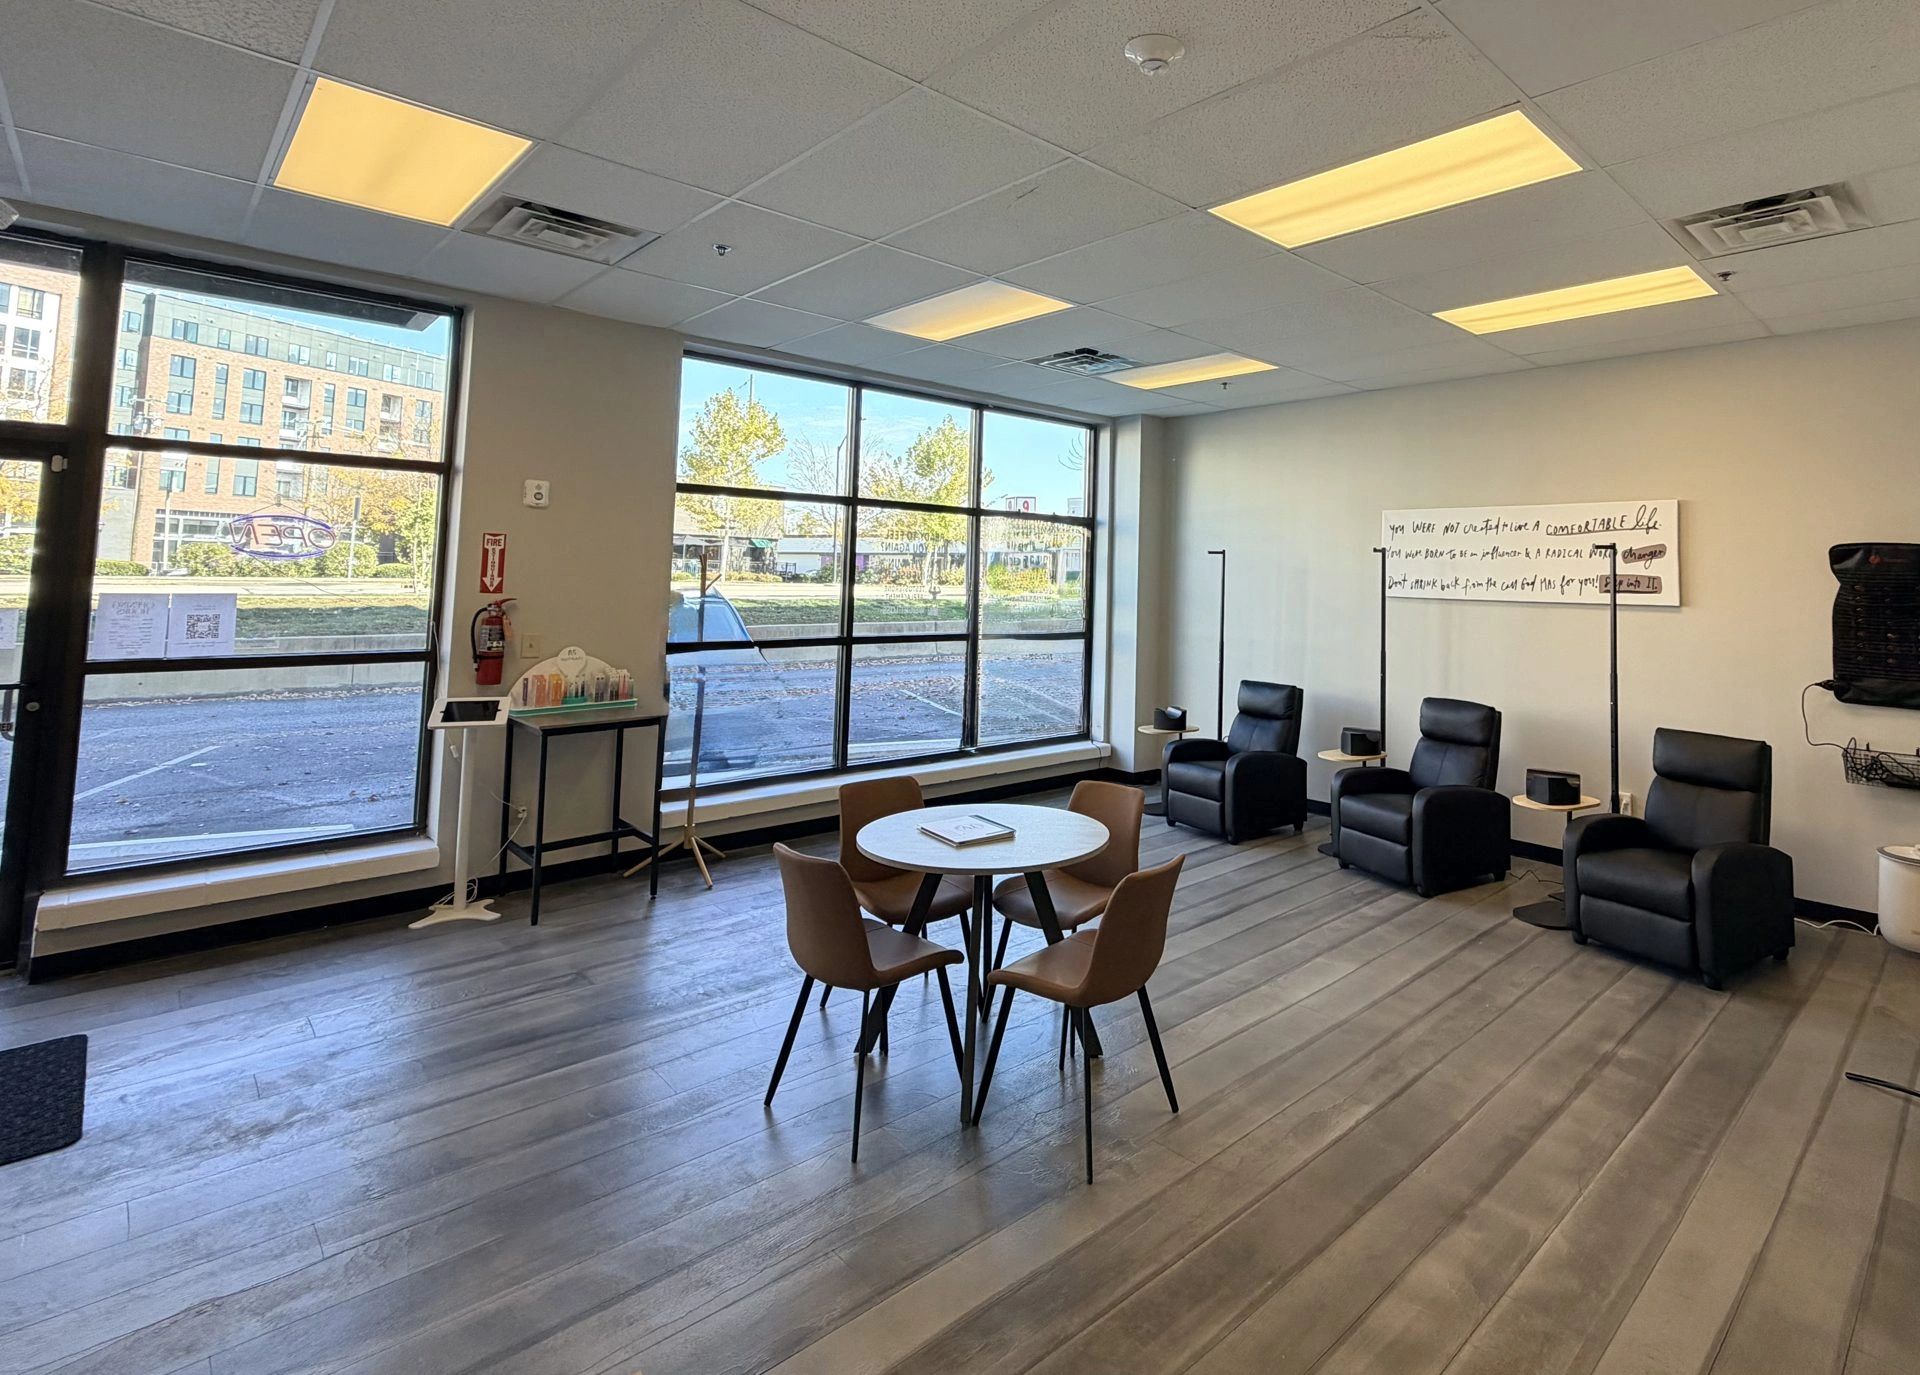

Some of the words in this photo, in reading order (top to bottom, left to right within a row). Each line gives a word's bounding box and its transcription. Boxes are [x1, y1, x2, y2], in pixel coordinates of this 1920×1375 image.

[1412, 520, 1436, 533] WERE
[1442, 522, 1460, 536] NOT
[1463, 516, 1501, 535] created
[1510, 521, 1530, 532] live
[1545, 514, 1627, 536] COMFORTABLE
[486, 538, 502, 546] FIRE
[1424, 548, 1445, 559] BORN
[1480, 545, 1522, 560] influencer
[1545, 548, 1583, 559] RADICAL
[1622, 546, 1664, 570] changer
[1440, 575, 1460, 591] back
[1461, 577, 1484, 596] from
[1484, 576, 1498, 591] the
[1501, 579, 1518, 591] call
[1520, 574, 1538, 592] God
[1540, 577, 1557, 592] HAS
[1560, 575, 1576, 595] for
[1578, 574, 1599, 596] you!
[1626, 576, 1641, 590] into
